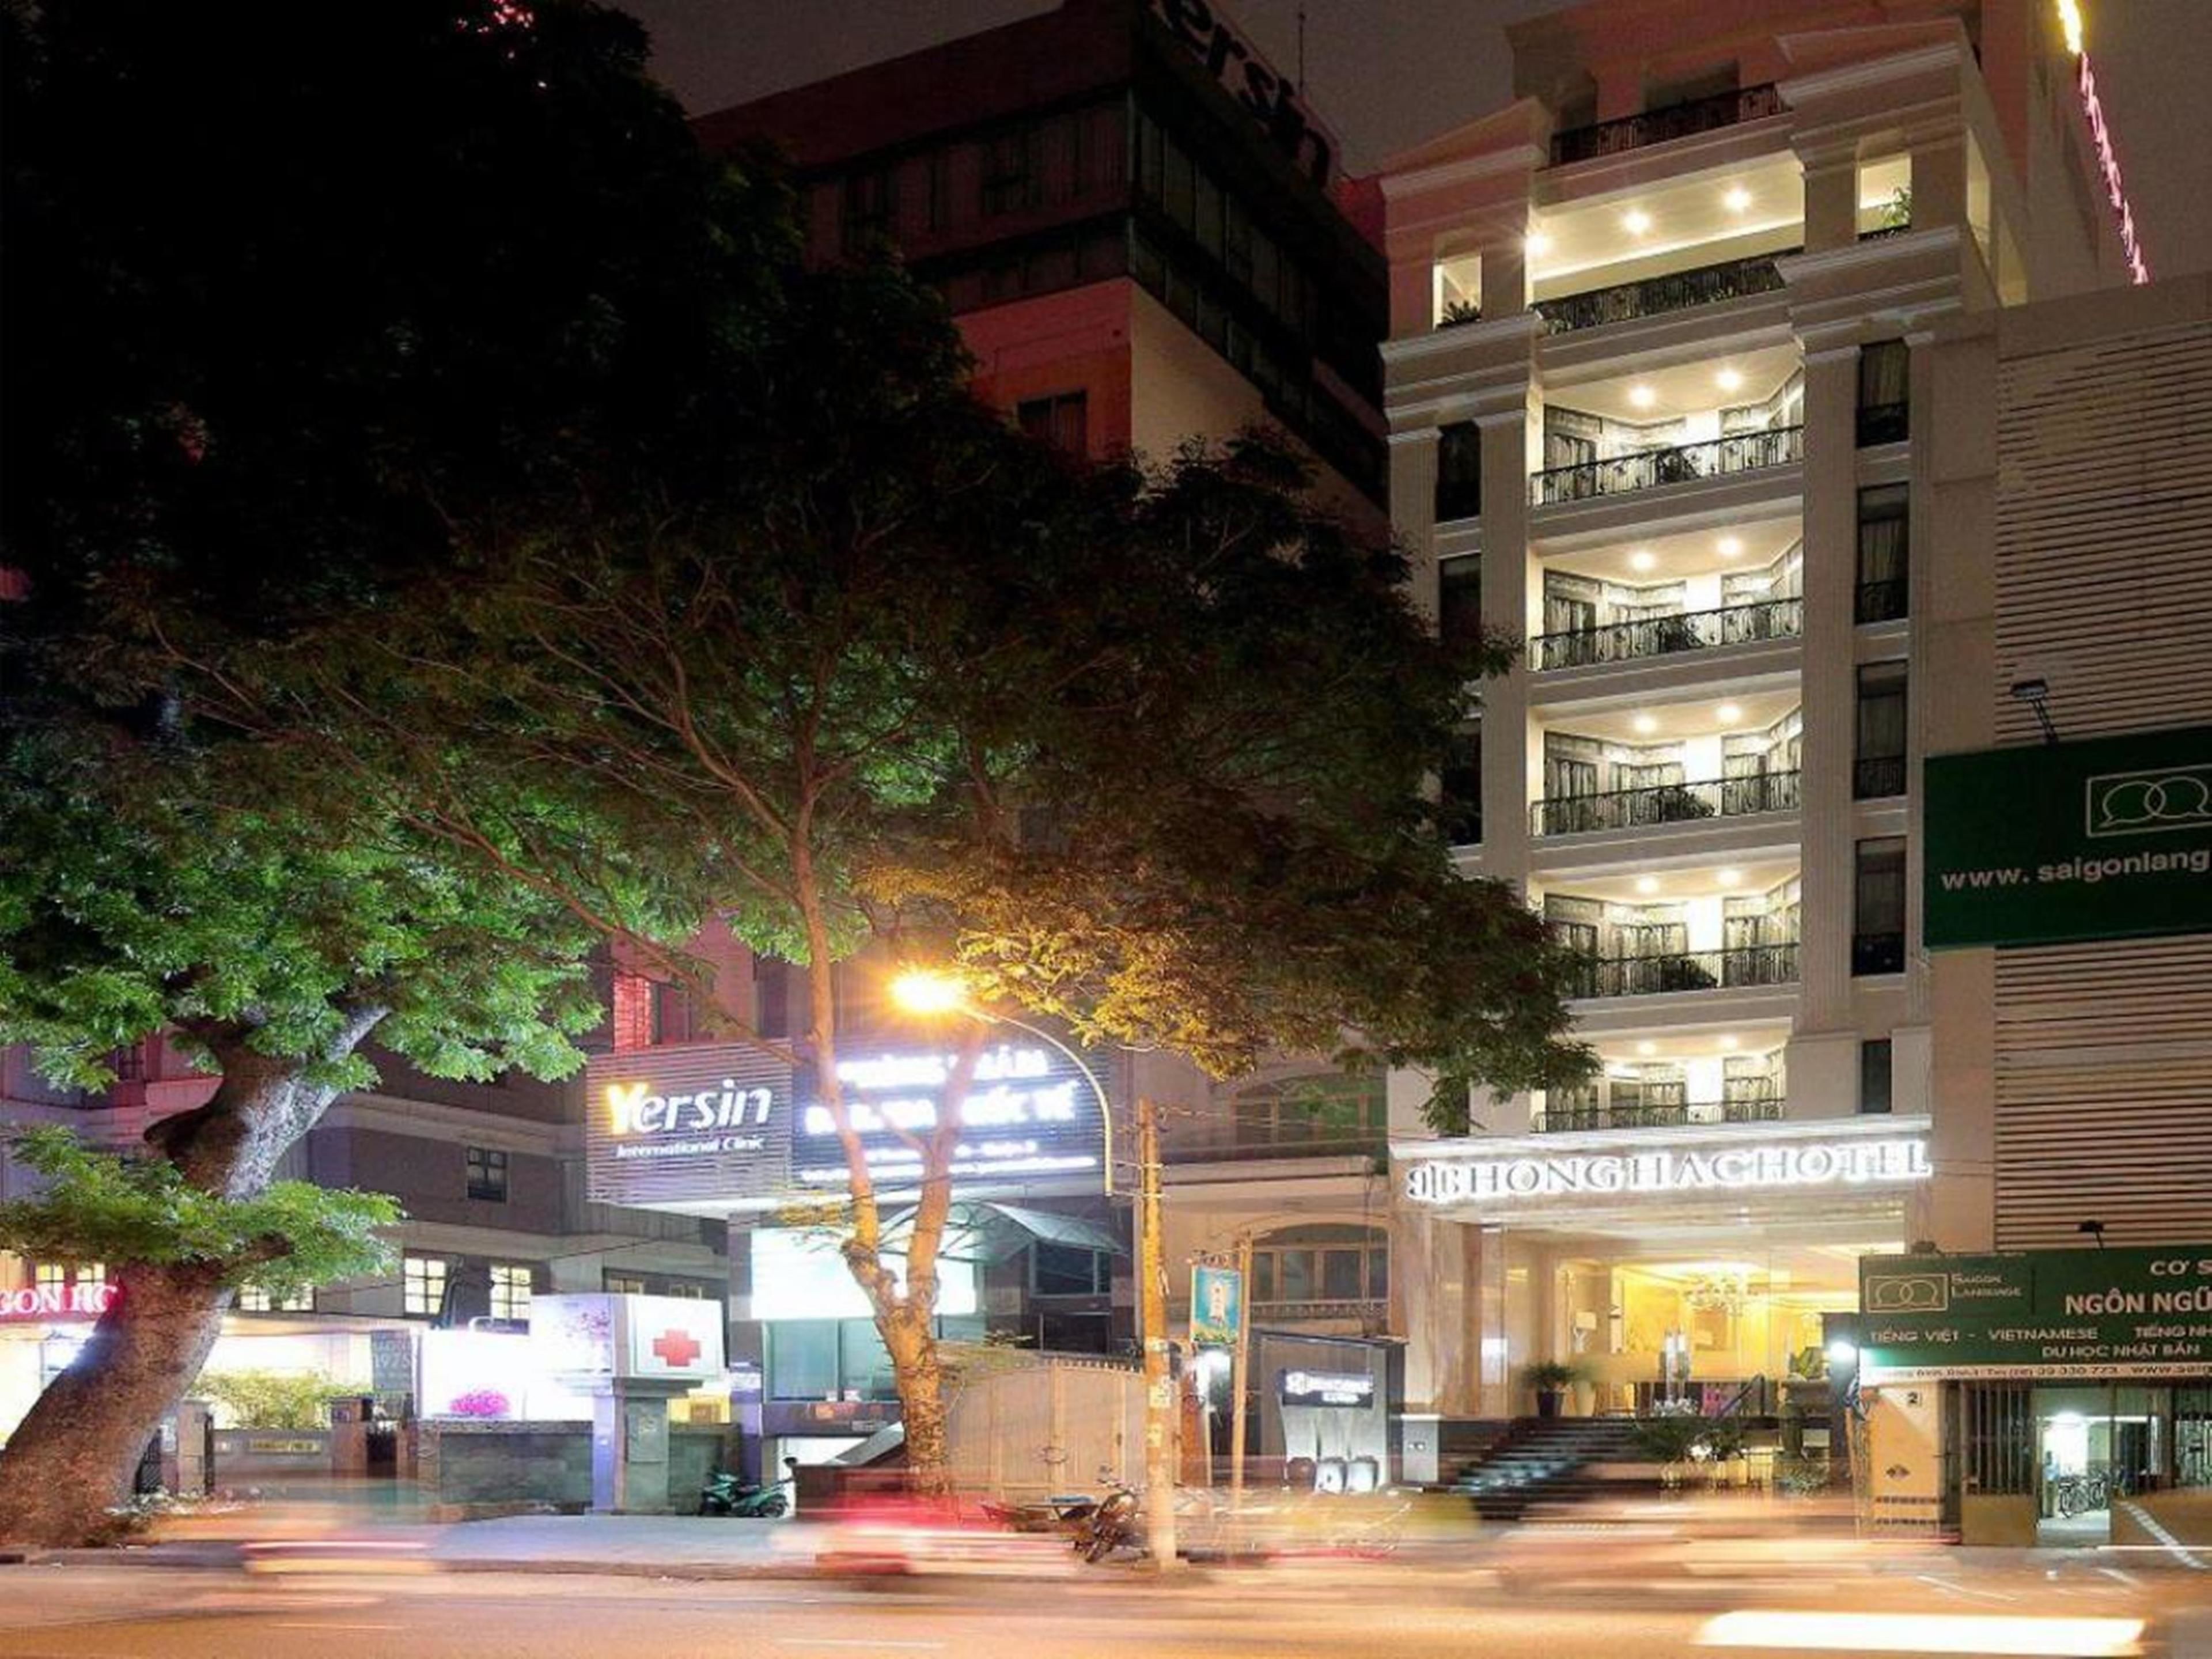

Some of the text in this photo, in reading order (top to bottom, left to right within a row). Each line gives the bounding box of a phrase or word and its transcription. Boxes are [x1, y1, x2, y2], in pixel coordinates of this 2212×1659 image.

[607, 1078, 772, 1134] Yersin
[616, 1134, 766, 1158] International Clinic
[2065, 1287, 2145, 1316] NGÔN
[1988, 1327, 2099, 1342] VIETNAMESE
